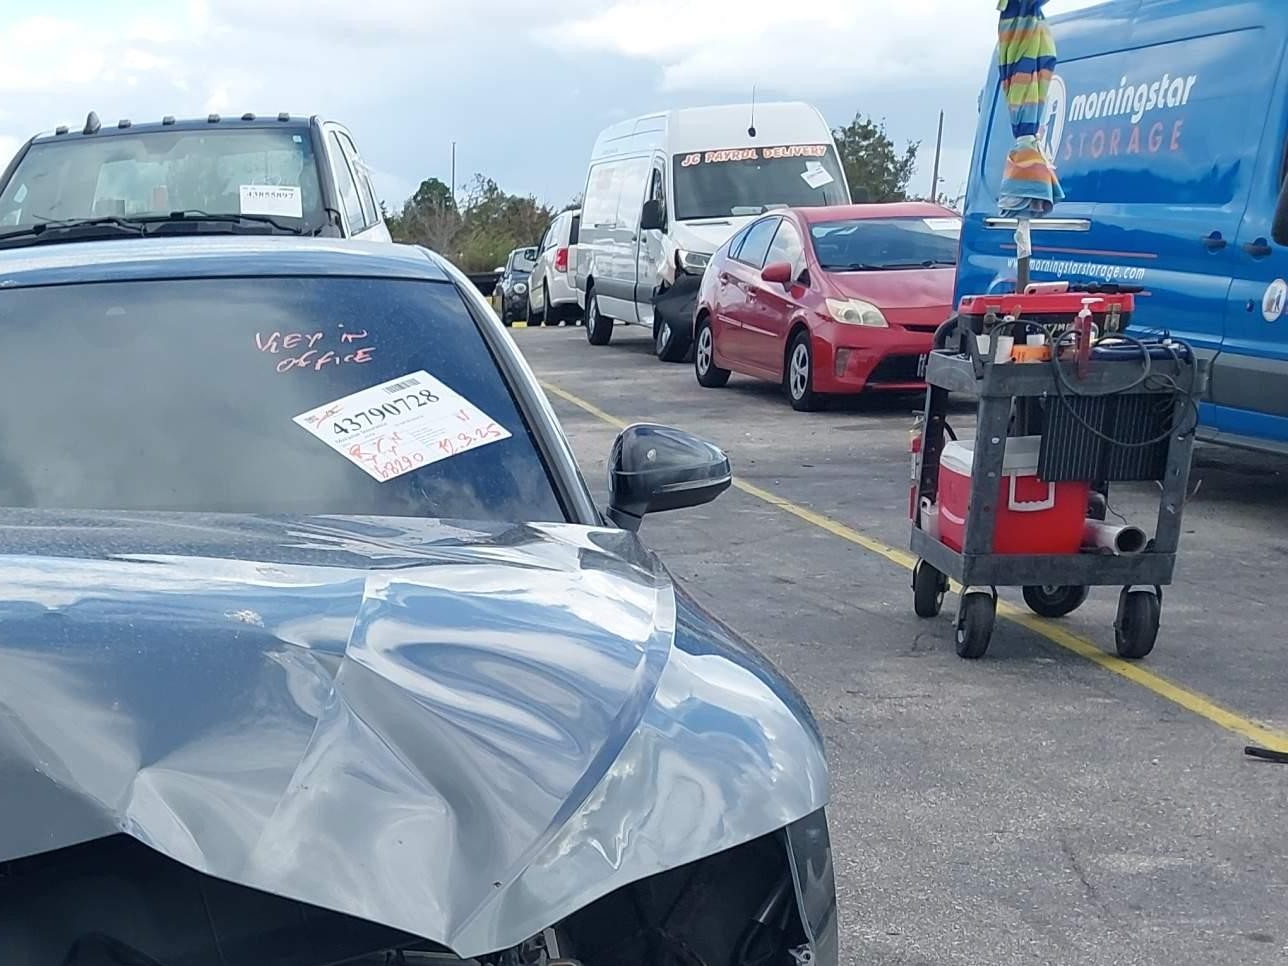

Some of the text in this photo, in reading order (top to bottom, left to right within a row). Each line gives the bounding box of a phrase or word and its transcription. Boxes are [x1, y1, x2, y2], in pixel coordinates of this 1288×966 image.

[1068, 74, 1197, 124] morningstar
[680, 152, 701, 167] JC
[762, 145, 827, 160] DELIVERY
[1064, 119, 1185, 161] STORAGE
[332, 389, 440, 436] 43790728
